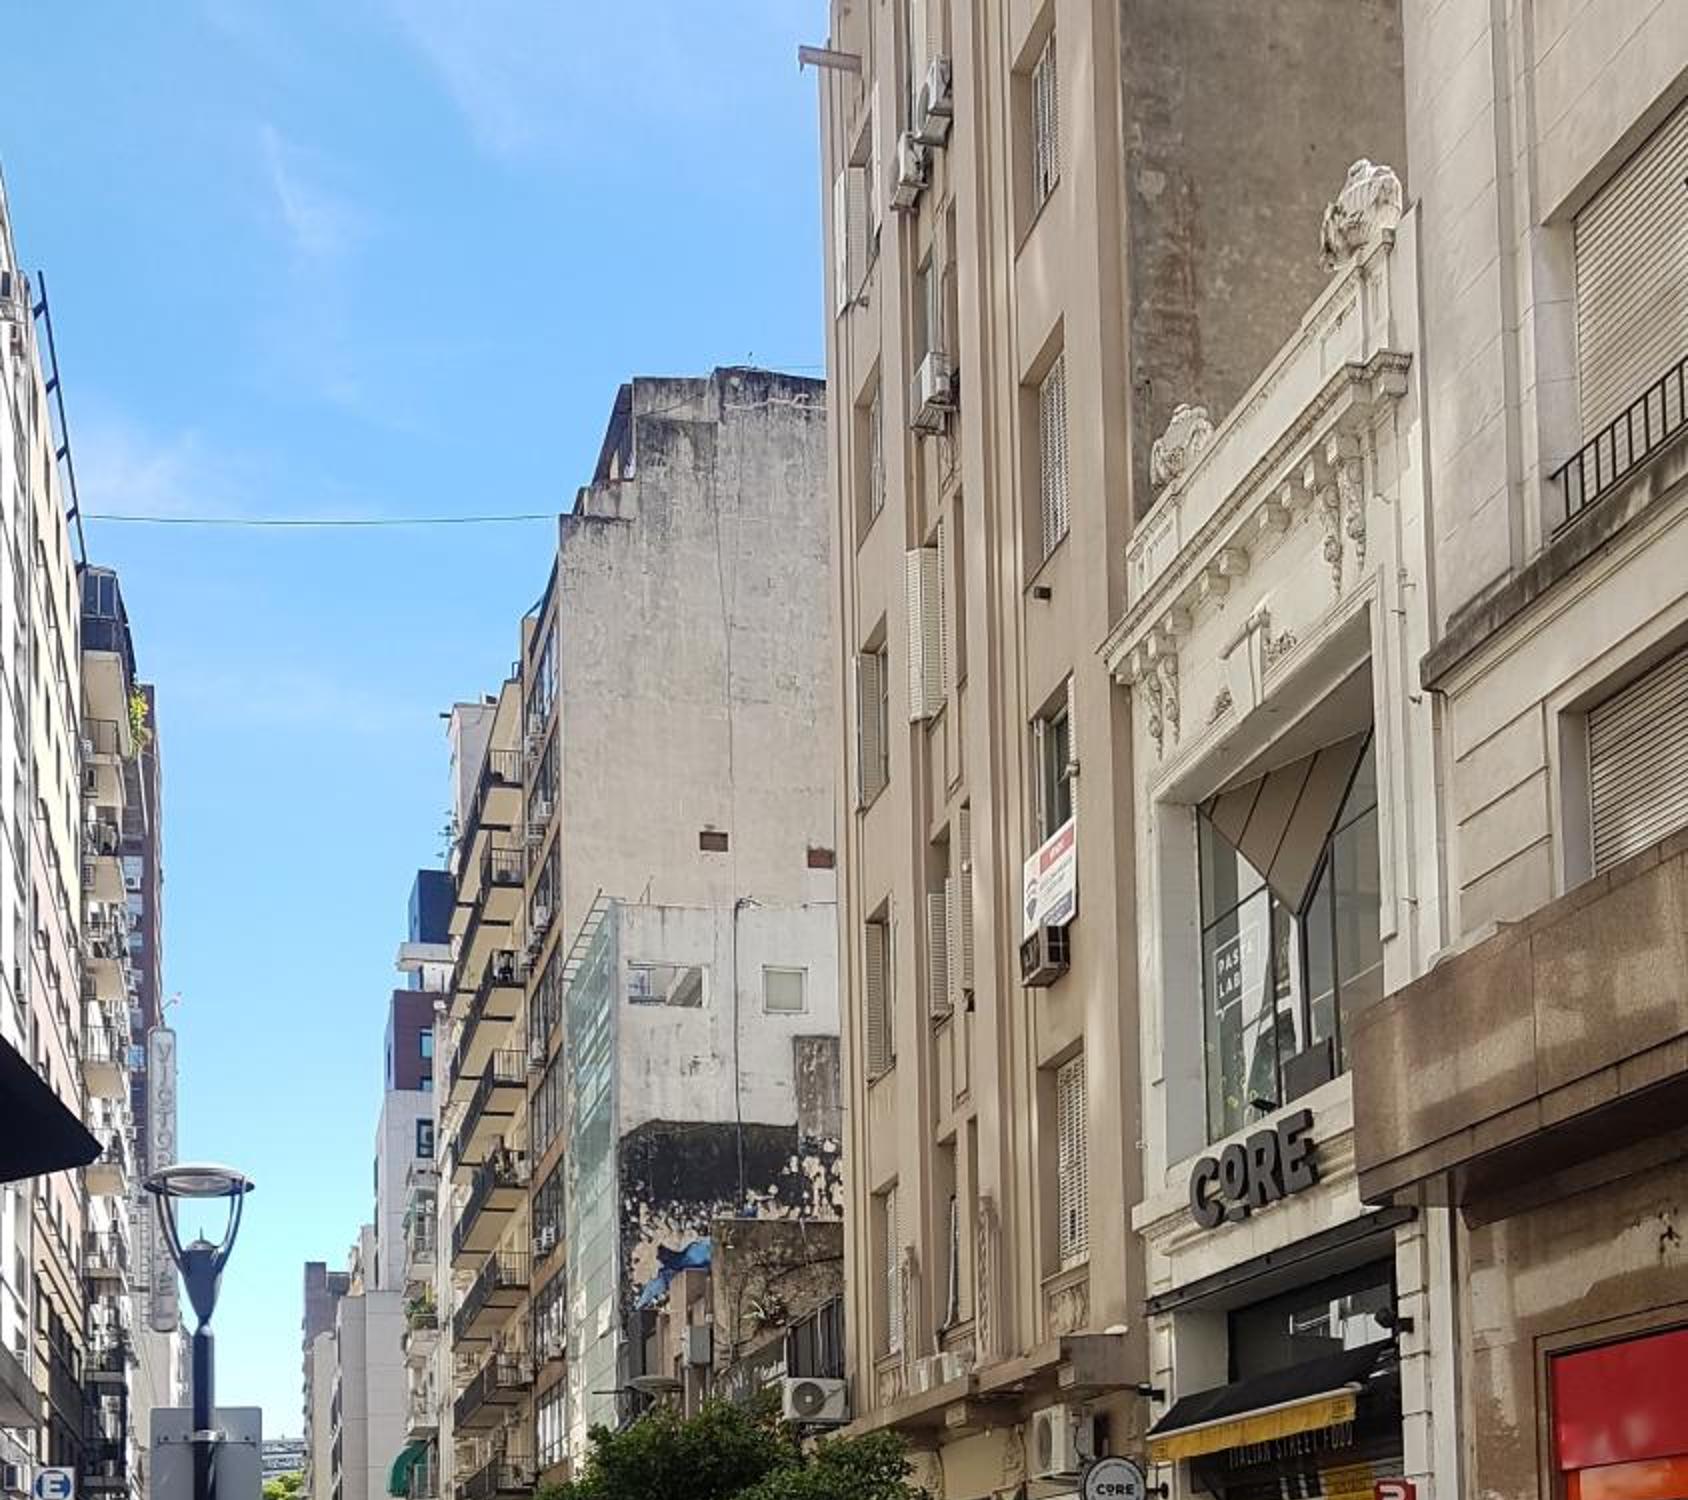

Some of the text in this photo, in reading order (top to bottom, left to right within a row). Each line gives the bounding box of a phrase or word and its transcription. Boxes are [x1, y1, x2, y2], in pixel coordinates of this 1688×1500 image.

[1219, 971, 1241, 998] LAB
[1189, 1107, 1320, 1229] CORE
[42, 1473, 65, 1499] E
[1096, 1483, 1135, 1497] CORE
